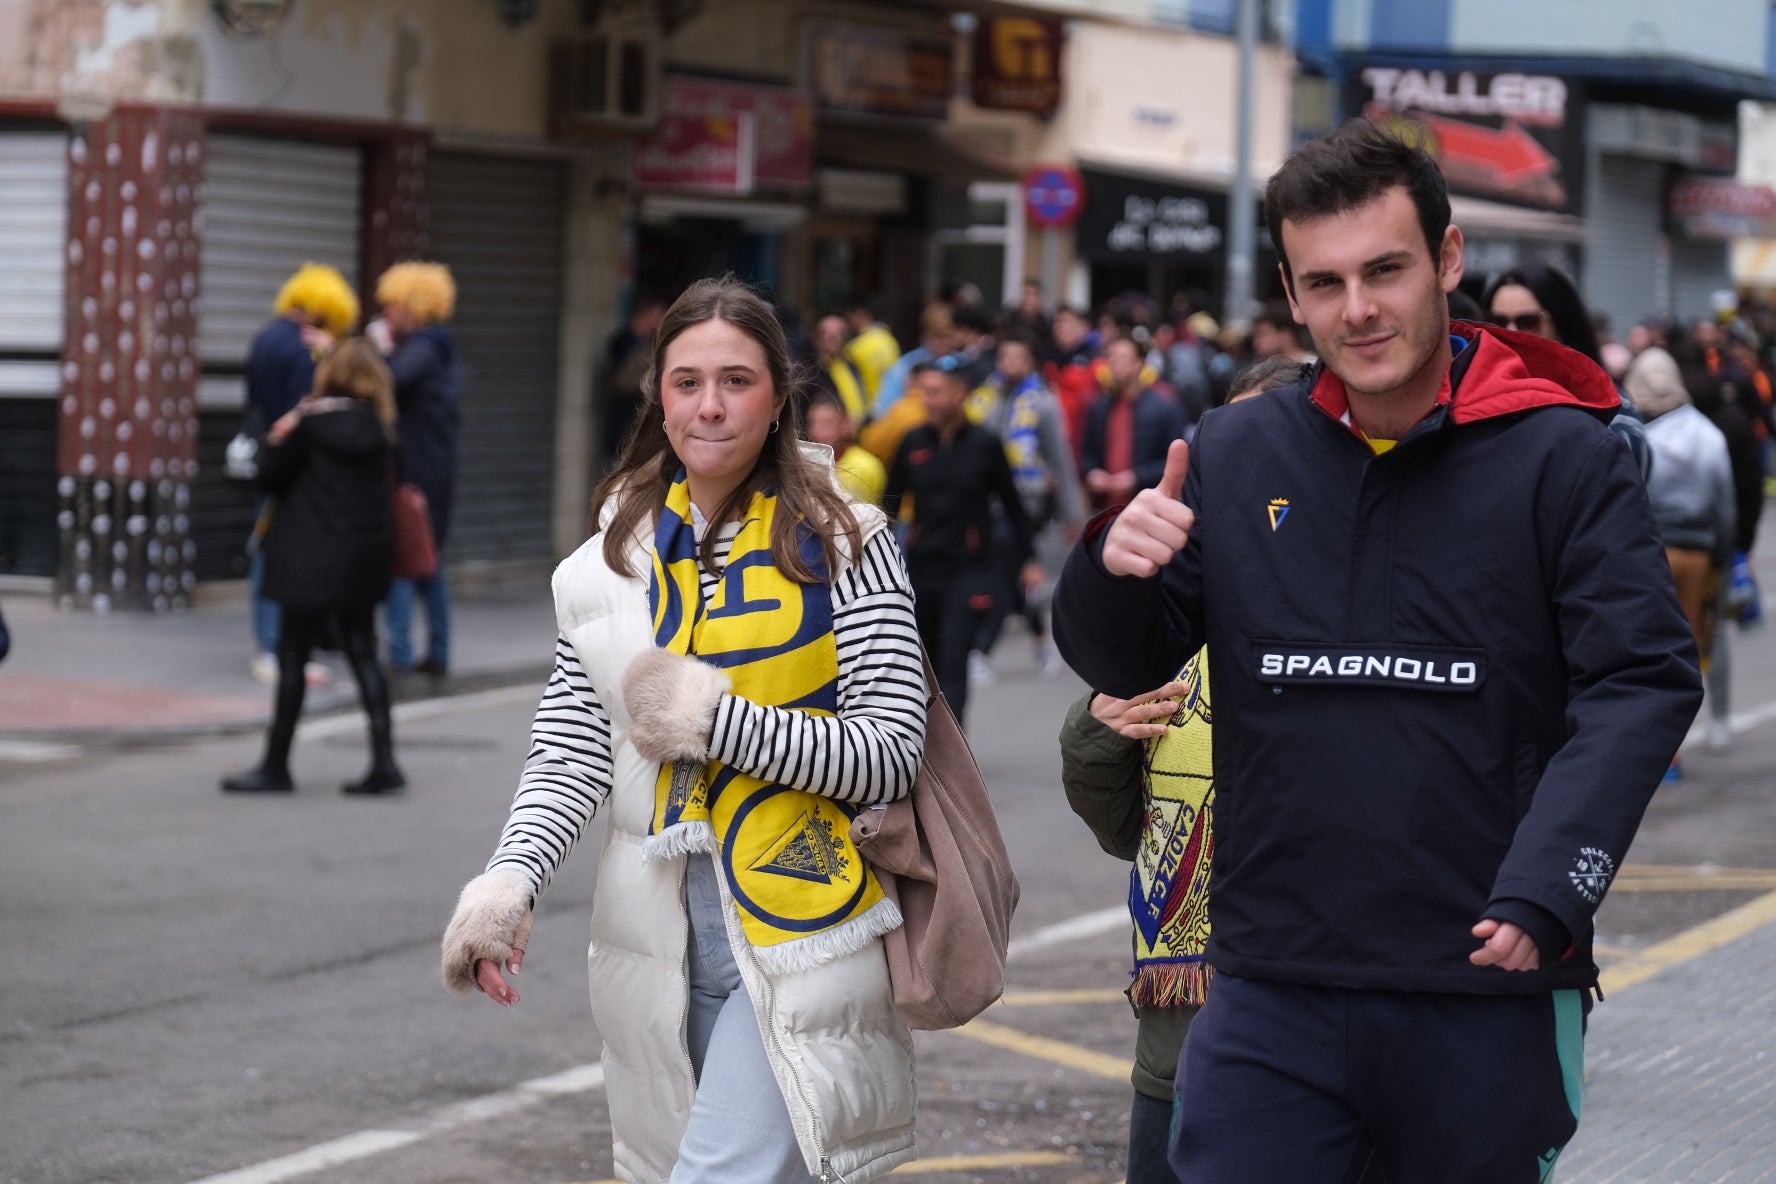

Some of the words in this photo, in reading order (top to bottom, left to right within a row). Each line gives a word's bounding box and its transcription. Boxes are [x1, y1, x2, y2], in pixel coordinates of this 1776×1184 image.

[1362, 68, 1567, 122] TALLER
[1261, 653, 1477, 685] SPAGNOLO
[1160, 803, 1195, 882] CADIZ
